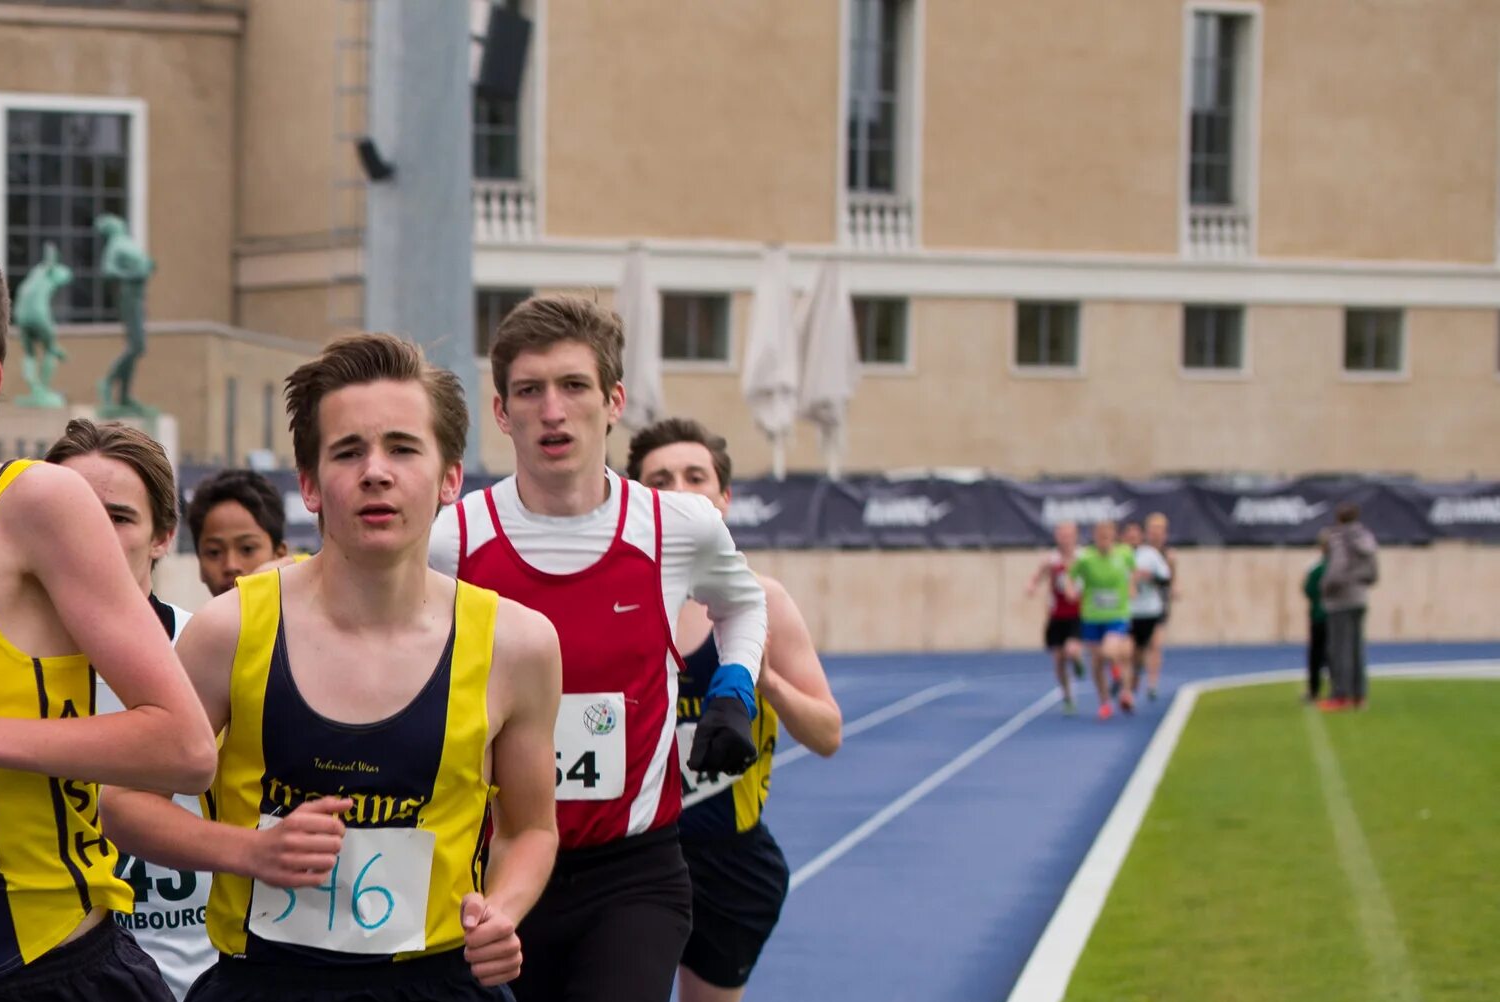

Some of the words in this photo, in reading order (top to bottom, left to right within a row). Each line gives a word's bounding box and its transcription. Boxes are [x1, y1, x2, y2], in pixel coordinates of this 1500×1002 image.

[313, 757, 354, 771] Technical
[358, 760, 380, 773] Wear
[555, 750, 600, 788] 4
[268, 776, 425, 825] trjans
